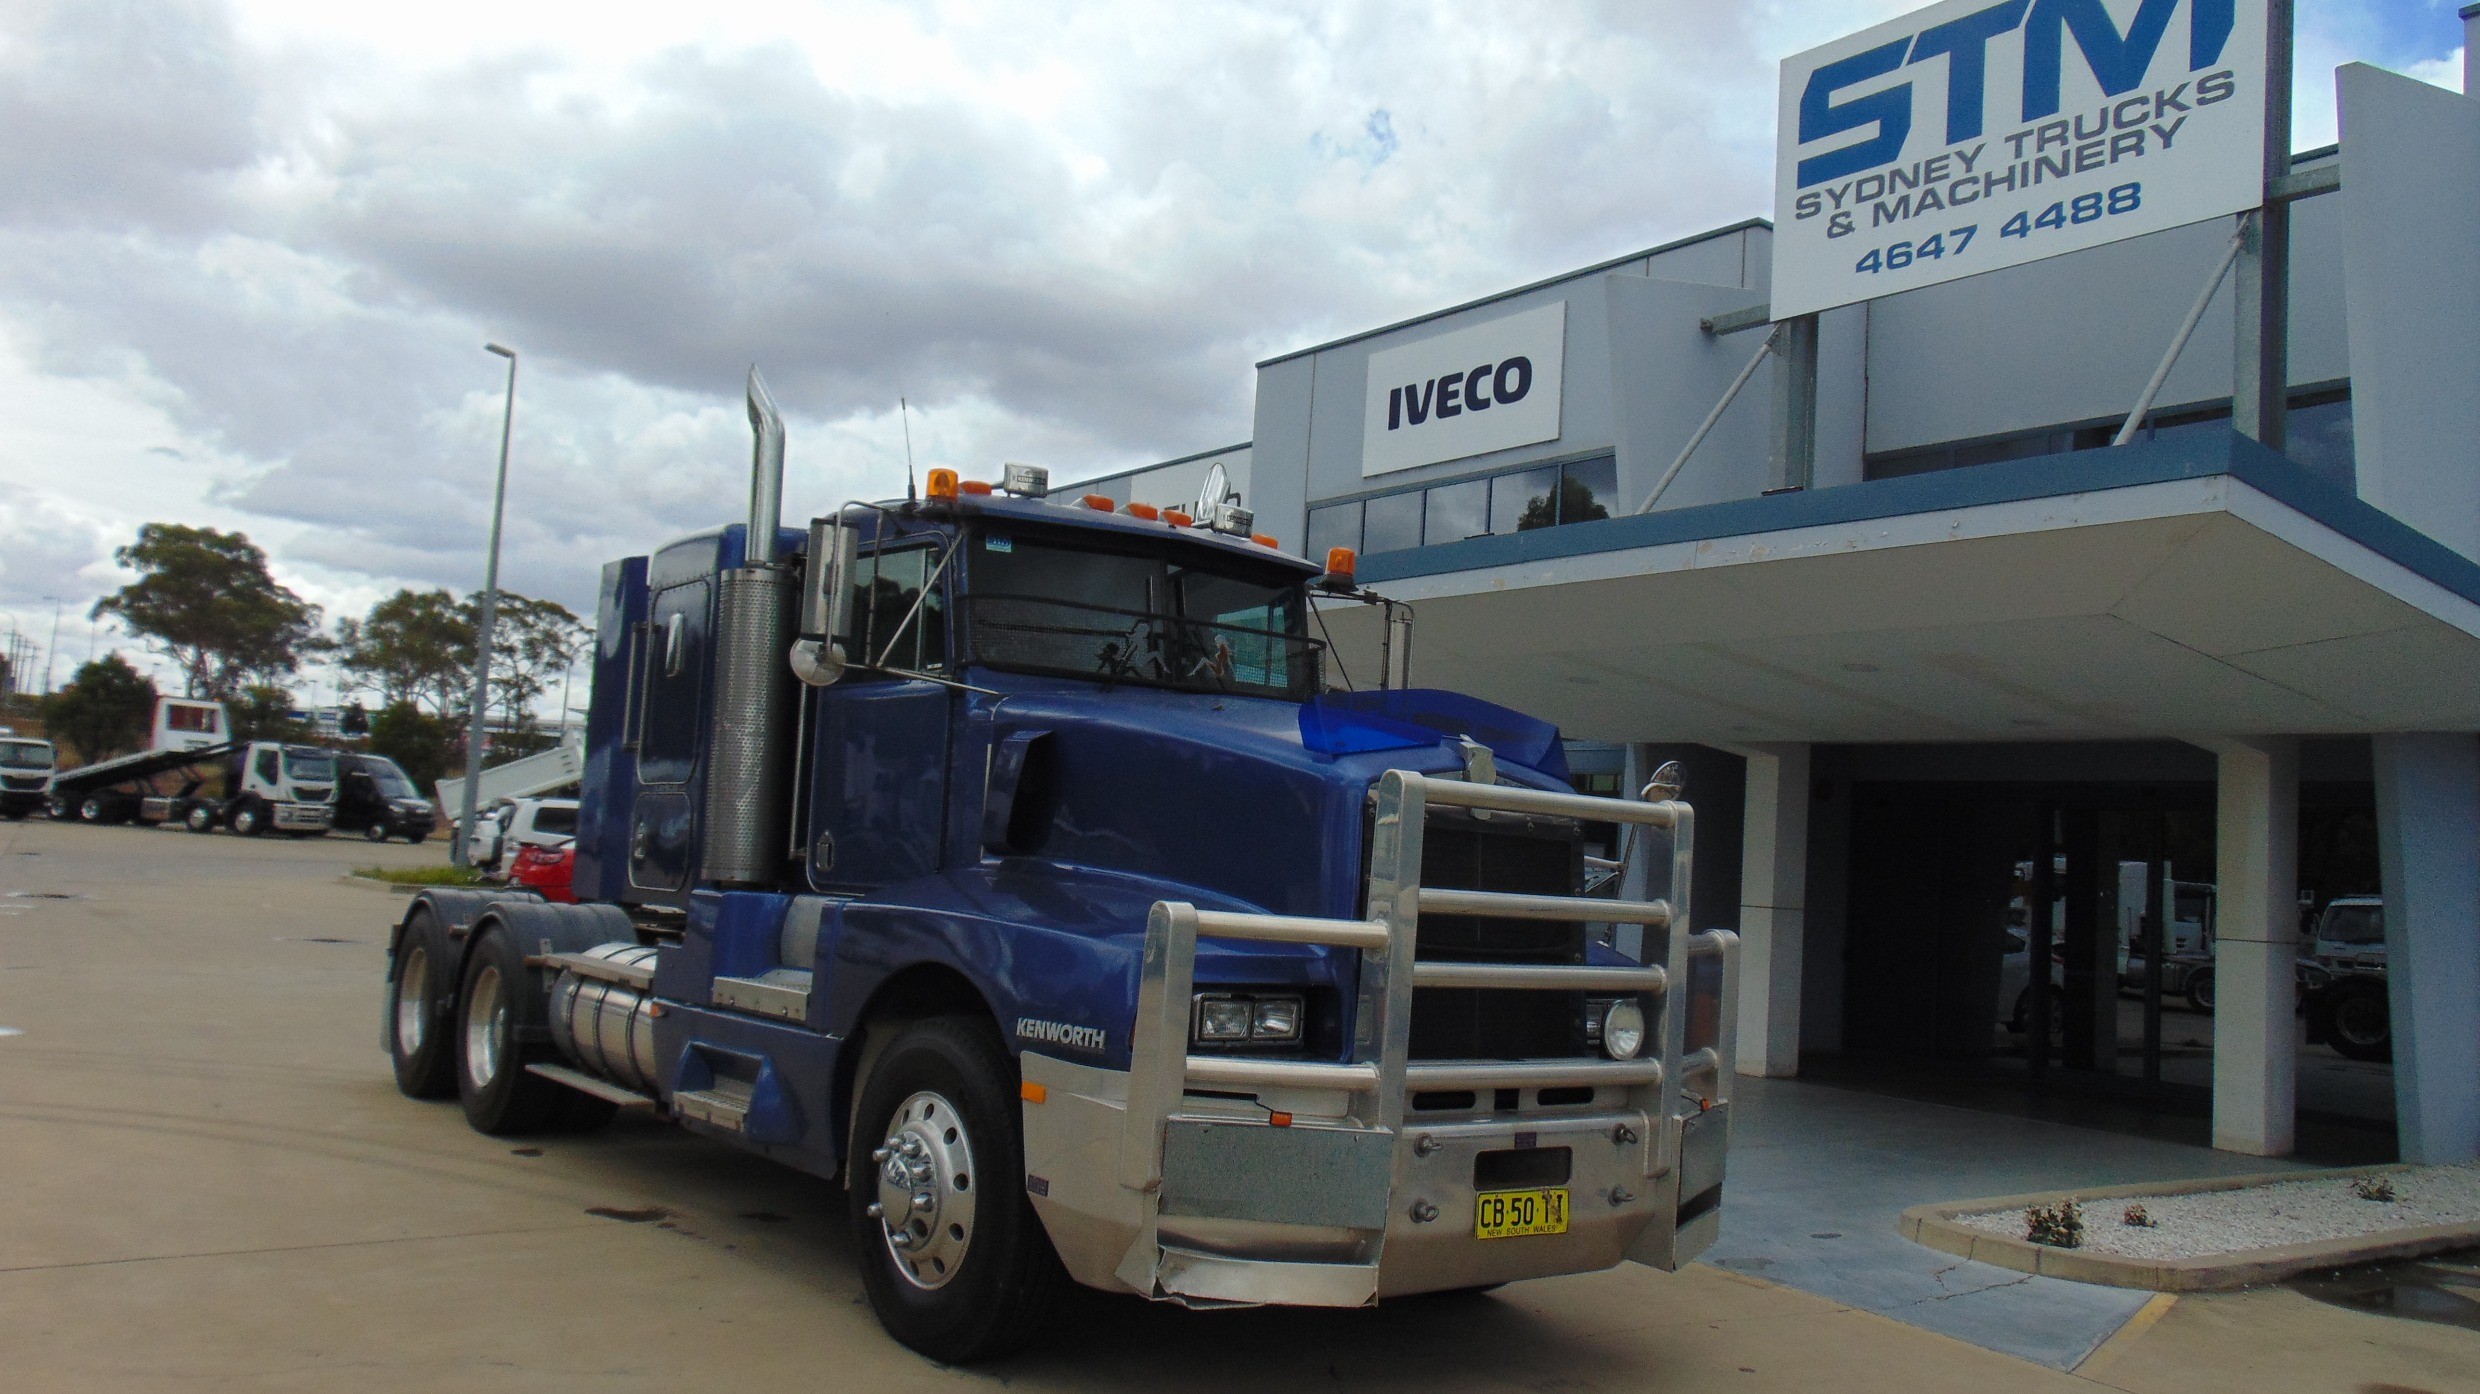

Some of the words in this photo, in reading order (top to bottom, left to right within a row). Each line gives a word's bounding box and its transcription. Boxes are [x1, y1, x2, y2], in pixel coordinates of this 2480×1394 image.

[1796, 0, 2236, 190] STM
[1795, 142, 1987, 221] SYDNEY
[2004, 70, 2236, 160] TRUCKS
[1826, 210, 1857, 239] &
[1872, 115, 2189, 228] MACHINERY
[1855, 224, 1979, 274] 4647
[2000, 181, 2142, 239] 4488
[1388, 355, 1533, 431] IVECO
[1016, 1018, 1106, 1049] KENWORTH
[1486, 1229, 1502, 1237] NEW
[1506, 1226, 1530, 1236] SOUTH
[1533, 1224, 1556, 1233] WALES
